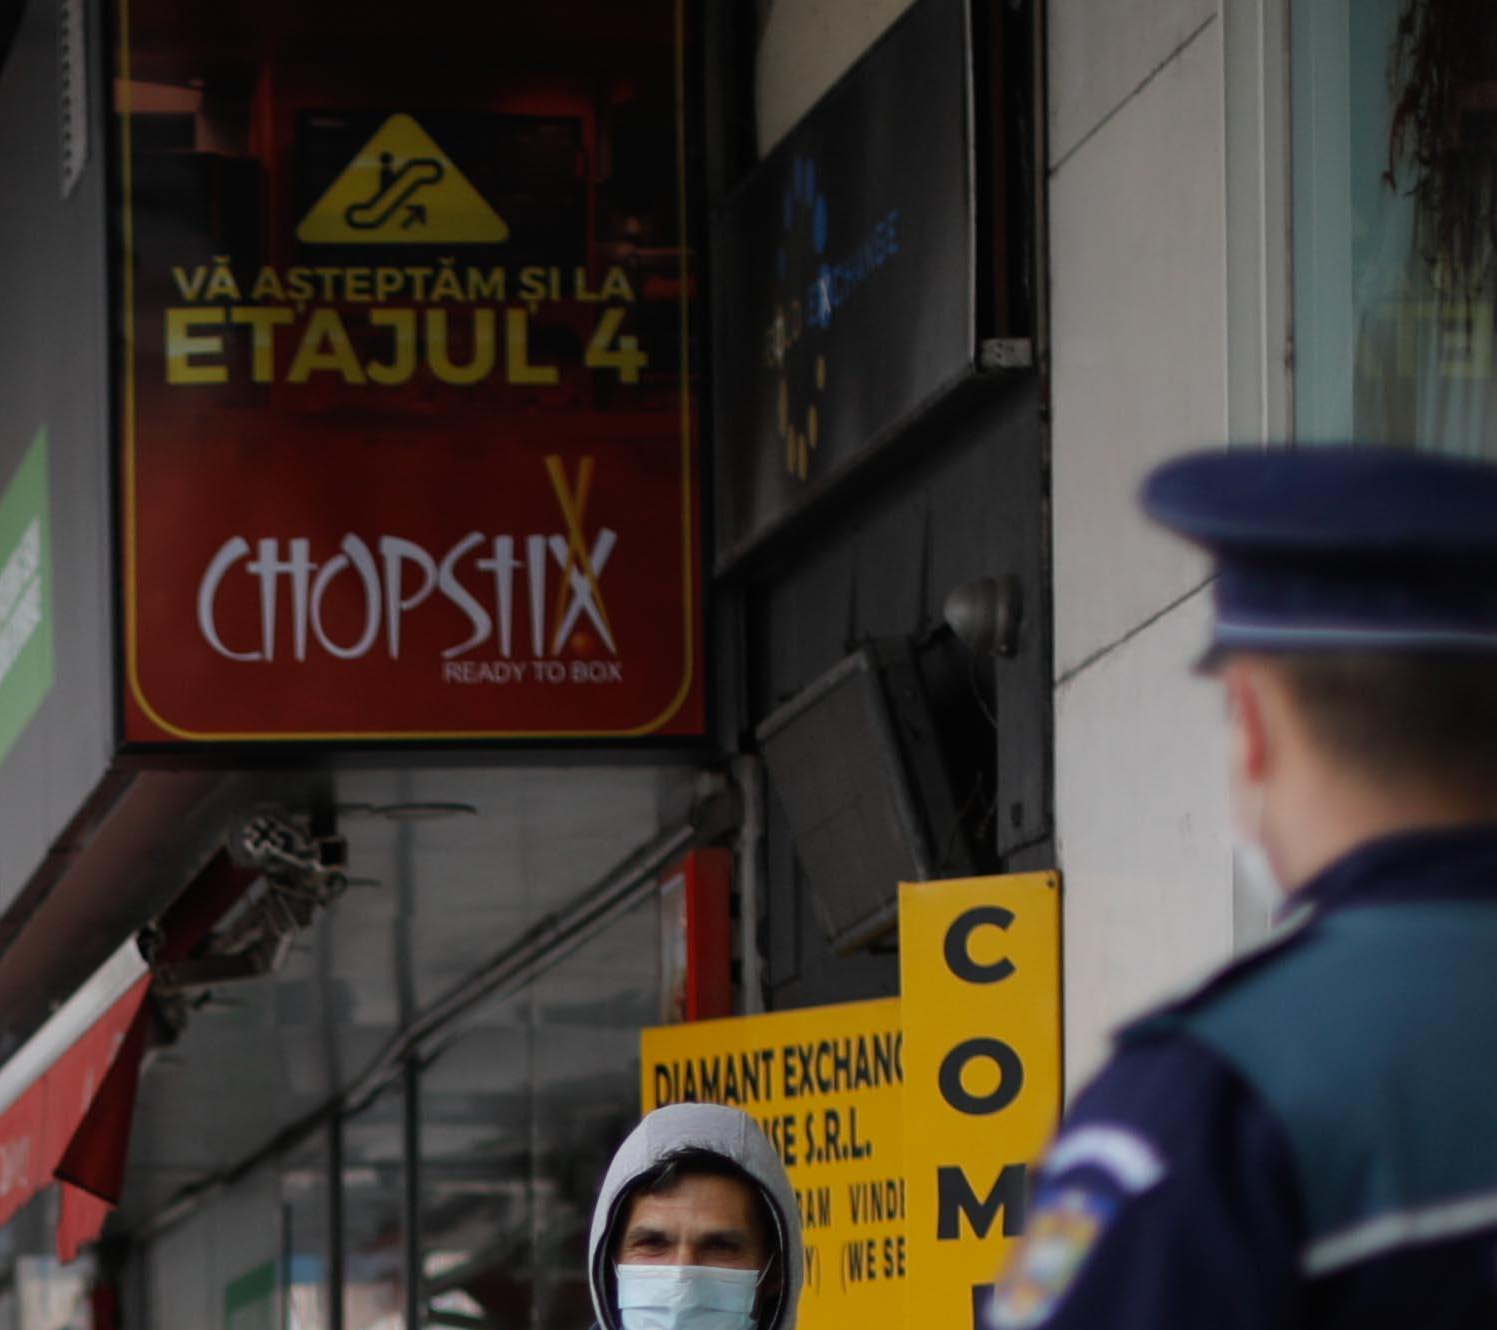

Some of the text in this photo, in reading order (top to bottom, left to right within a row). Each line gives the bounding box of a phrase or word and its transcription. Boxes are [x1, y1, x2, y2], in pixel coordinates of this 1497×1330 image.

[173, 256, 241, 301] VĂ
[518, 267, 563, 320] ȘI
[576, 266, 634, 301] LA
[165, 305, 648, 385] ETAJUL 4
[196, 528, 618, 662] CHOPSTIX
[443, 660, 623, 684] READY TO BOX
[654, 1049, 773, 1108] DIAMANT
[805, 1106, 872, 1164] S.R.L.
